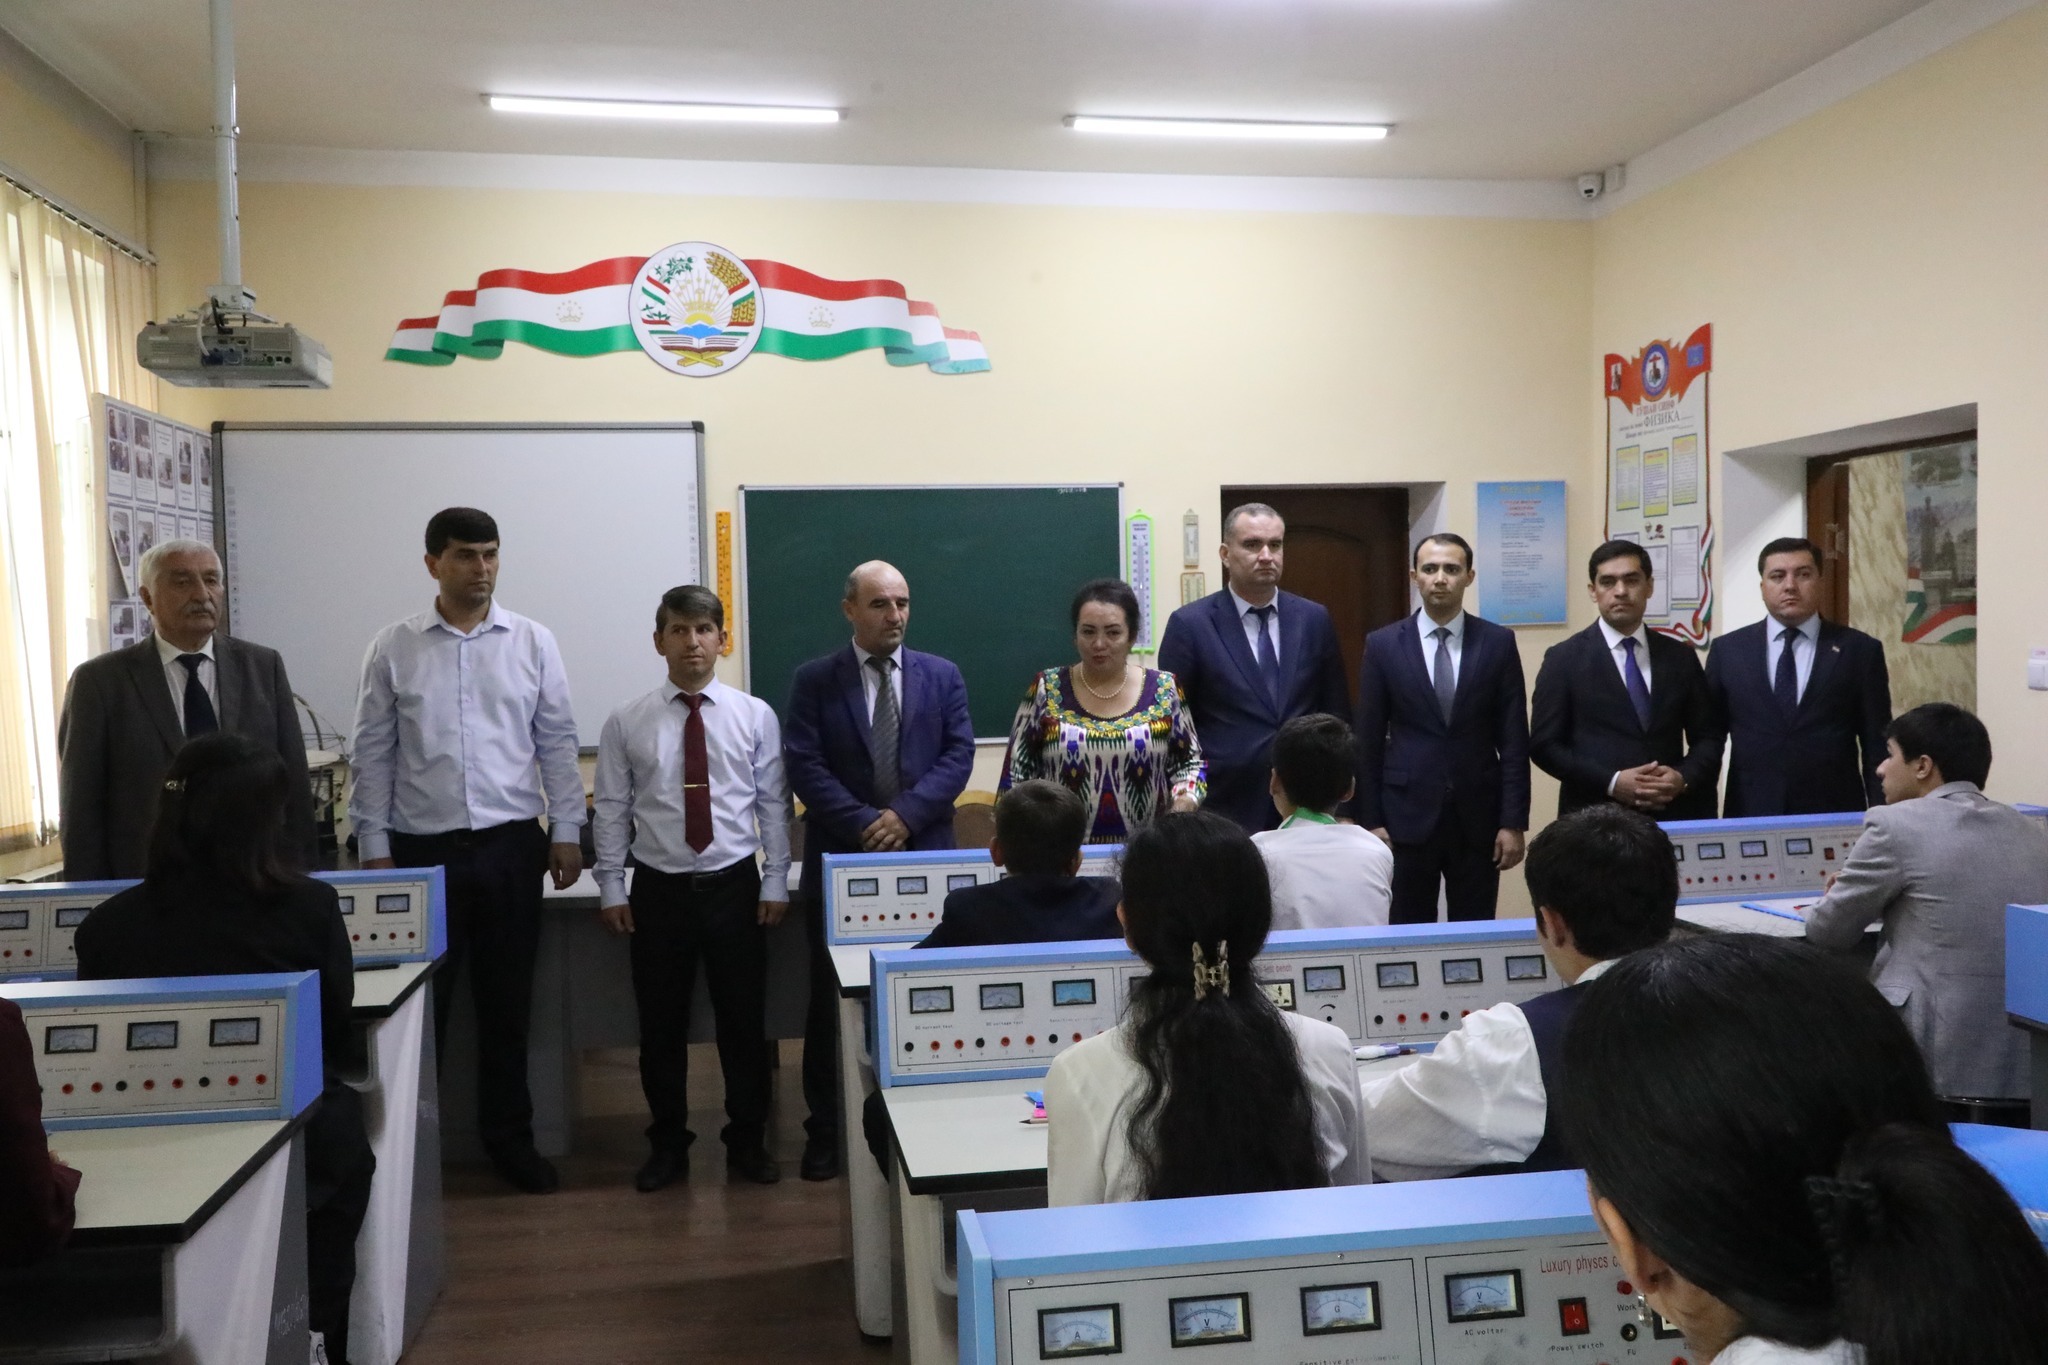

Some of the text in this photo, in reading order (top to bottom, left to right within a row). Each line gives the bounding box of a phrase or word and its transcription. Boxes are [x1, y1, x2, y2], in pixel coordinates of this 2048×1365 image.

[1644, 410, 1680, 427] ФИЗИКА
[1540, 1257, 1572, 1275] Luxury
[1576, 1254, 1609, 1274] physcs
